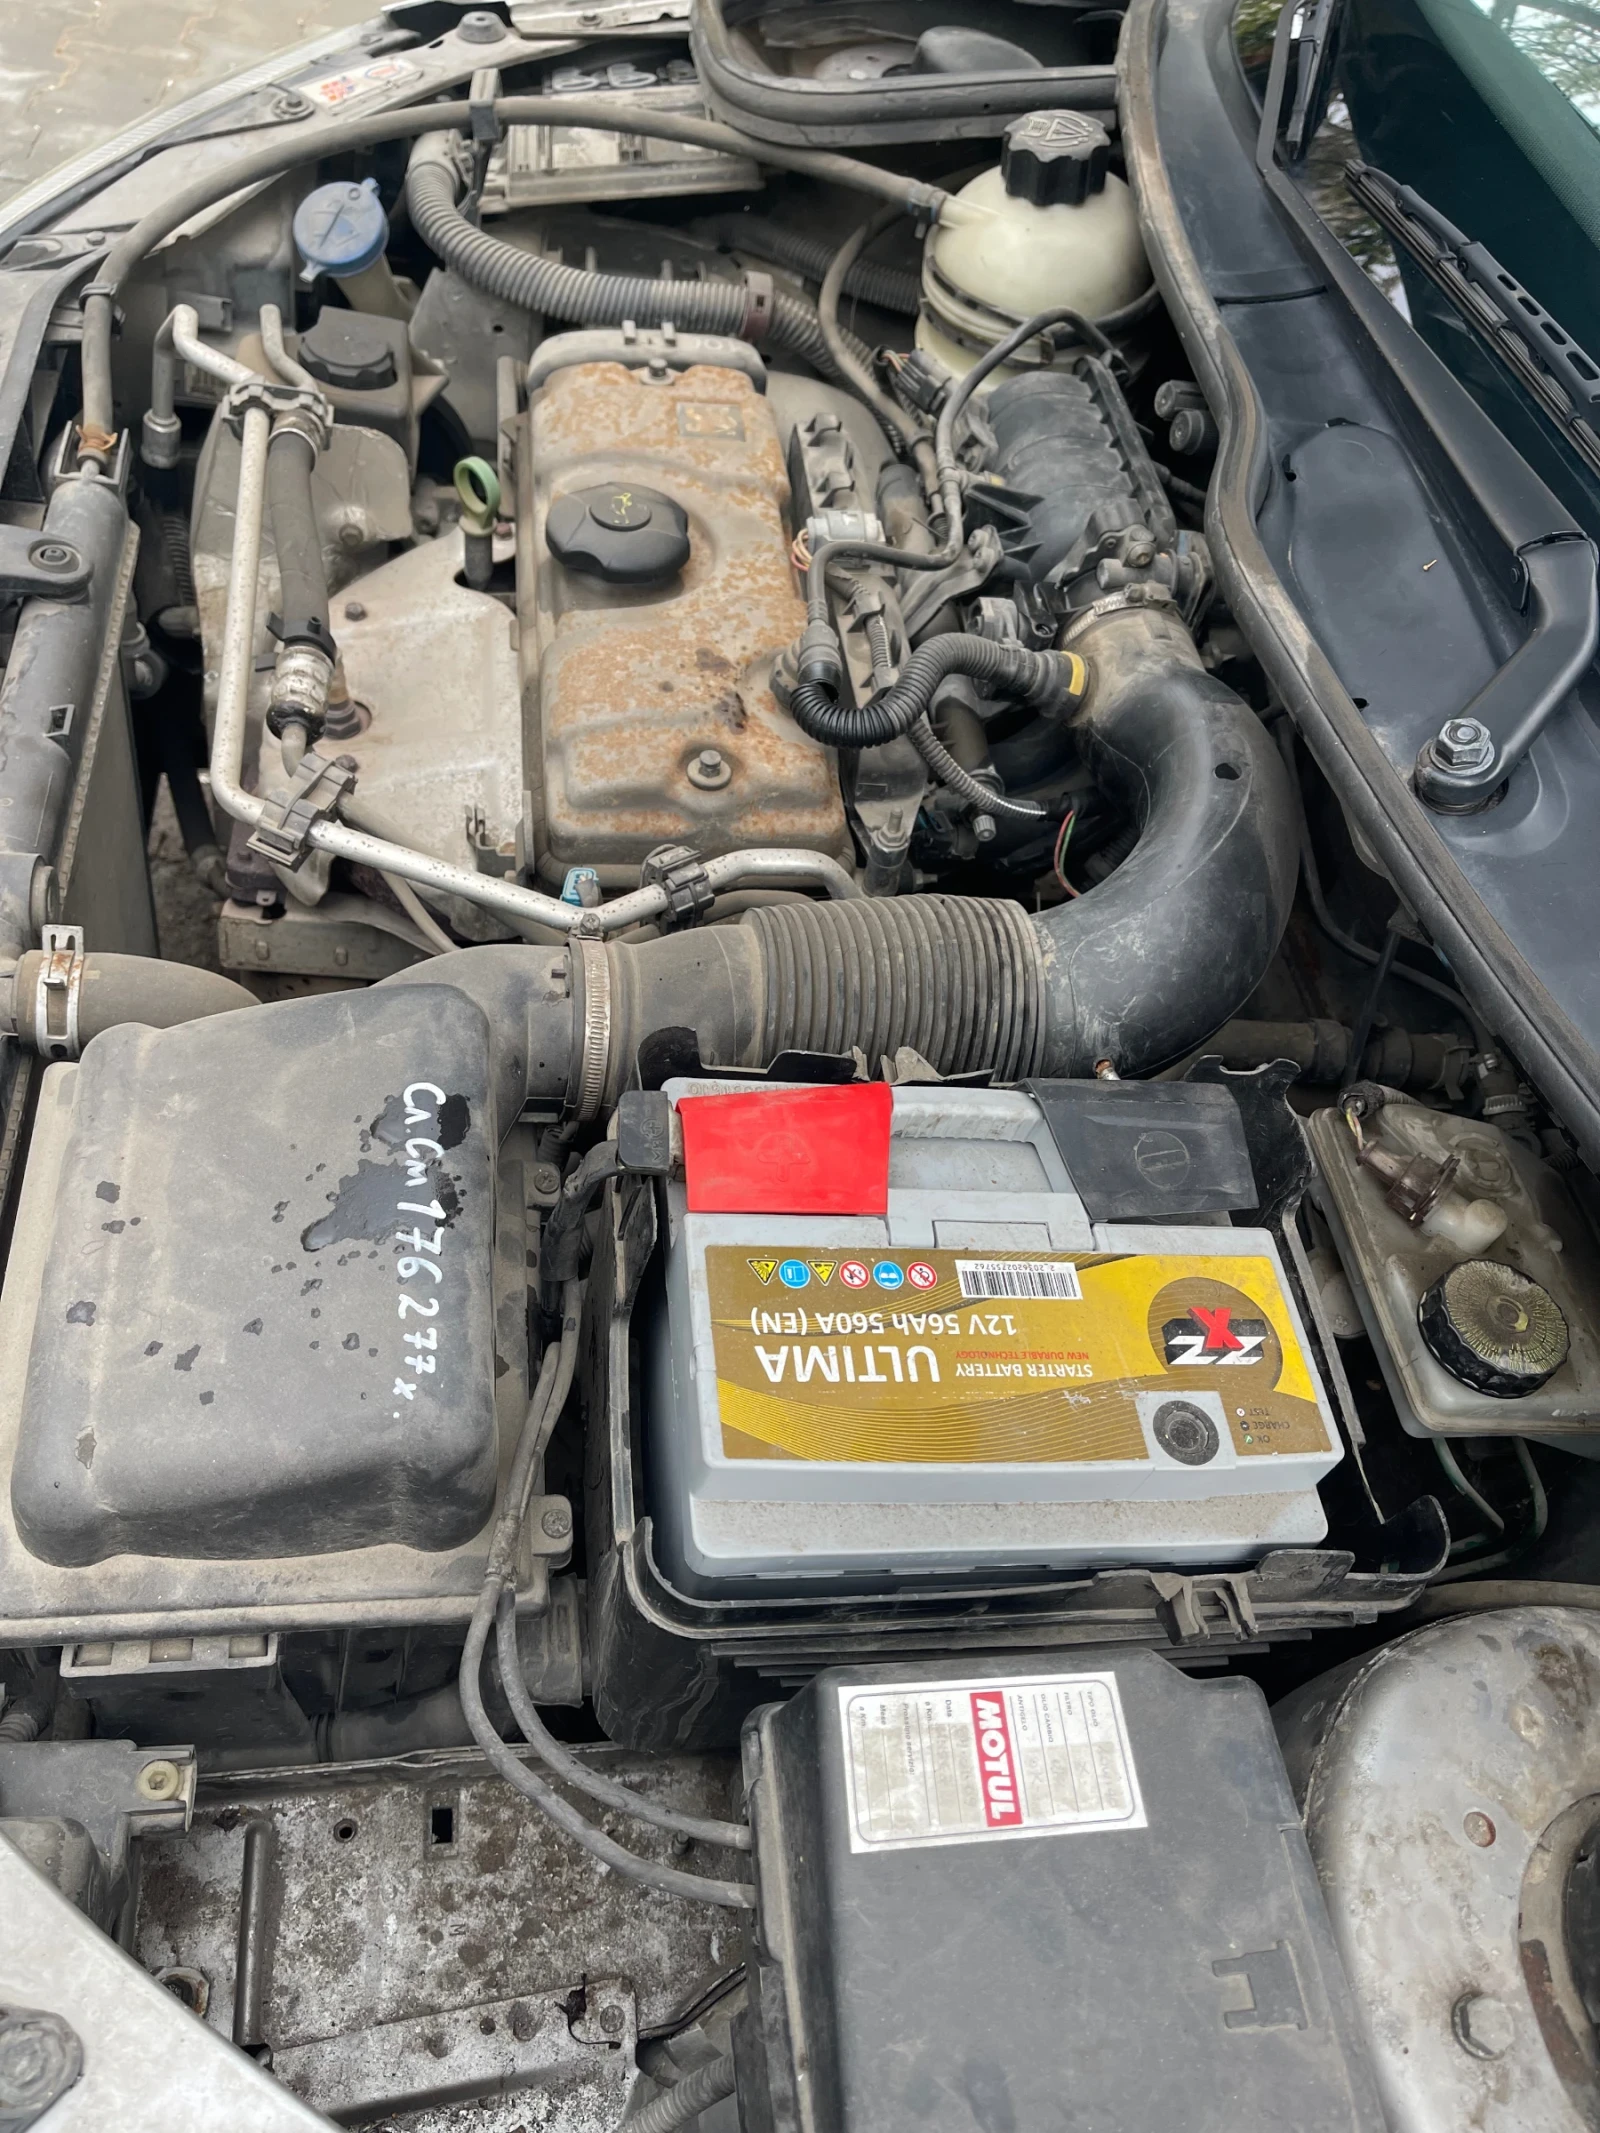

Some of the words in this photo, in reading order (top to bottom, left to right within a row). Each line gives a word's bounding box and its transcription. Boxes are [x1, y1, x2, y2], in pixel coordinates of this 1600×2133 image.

[751, 1307, 808, 1336] (EN)
[815, 1311, 883, 1335] 560A
[896, 1312, 960, 1336] 56Ah
[969, 1313, 1018, 1336] 12V
[754, 1345, 941, 1383] ULTIMA
[956, 1350, 1023, 1360] TECHNOLOGY
[1025, 1351, 1066, 1360] DURABLE
[1067, 1352, 1090, 1360] NEW
[956, 1362, 1024, 1378] BATTERY
[1029, 1363, 1094, 1378] STARTER
[1250, 1408, 1270, 1417] TEST
[1252, 1420, 1291, 1430] CHARGE
[1258, 1435, 1270, 1444] OK
[1040, 1693, 1048, 1712] OLIO
[1063, 1691, 1073, 1716] FILTRO
[1087, 1690, 1096, 1707] TIPO
[880, 1704, 888, 1726] Mese
[945, 1699, 953, 1718] Data
[1016, 1694, 1028, 1732] ANTIGELO
[1091, 1709, 1100, 1727] OLIO
[903, 1702, 911, 1740] Prossimo
[1043, 1713, 1053, 1743] CAMBIO
[976, 1698, 1016, 1820] MOTUL
